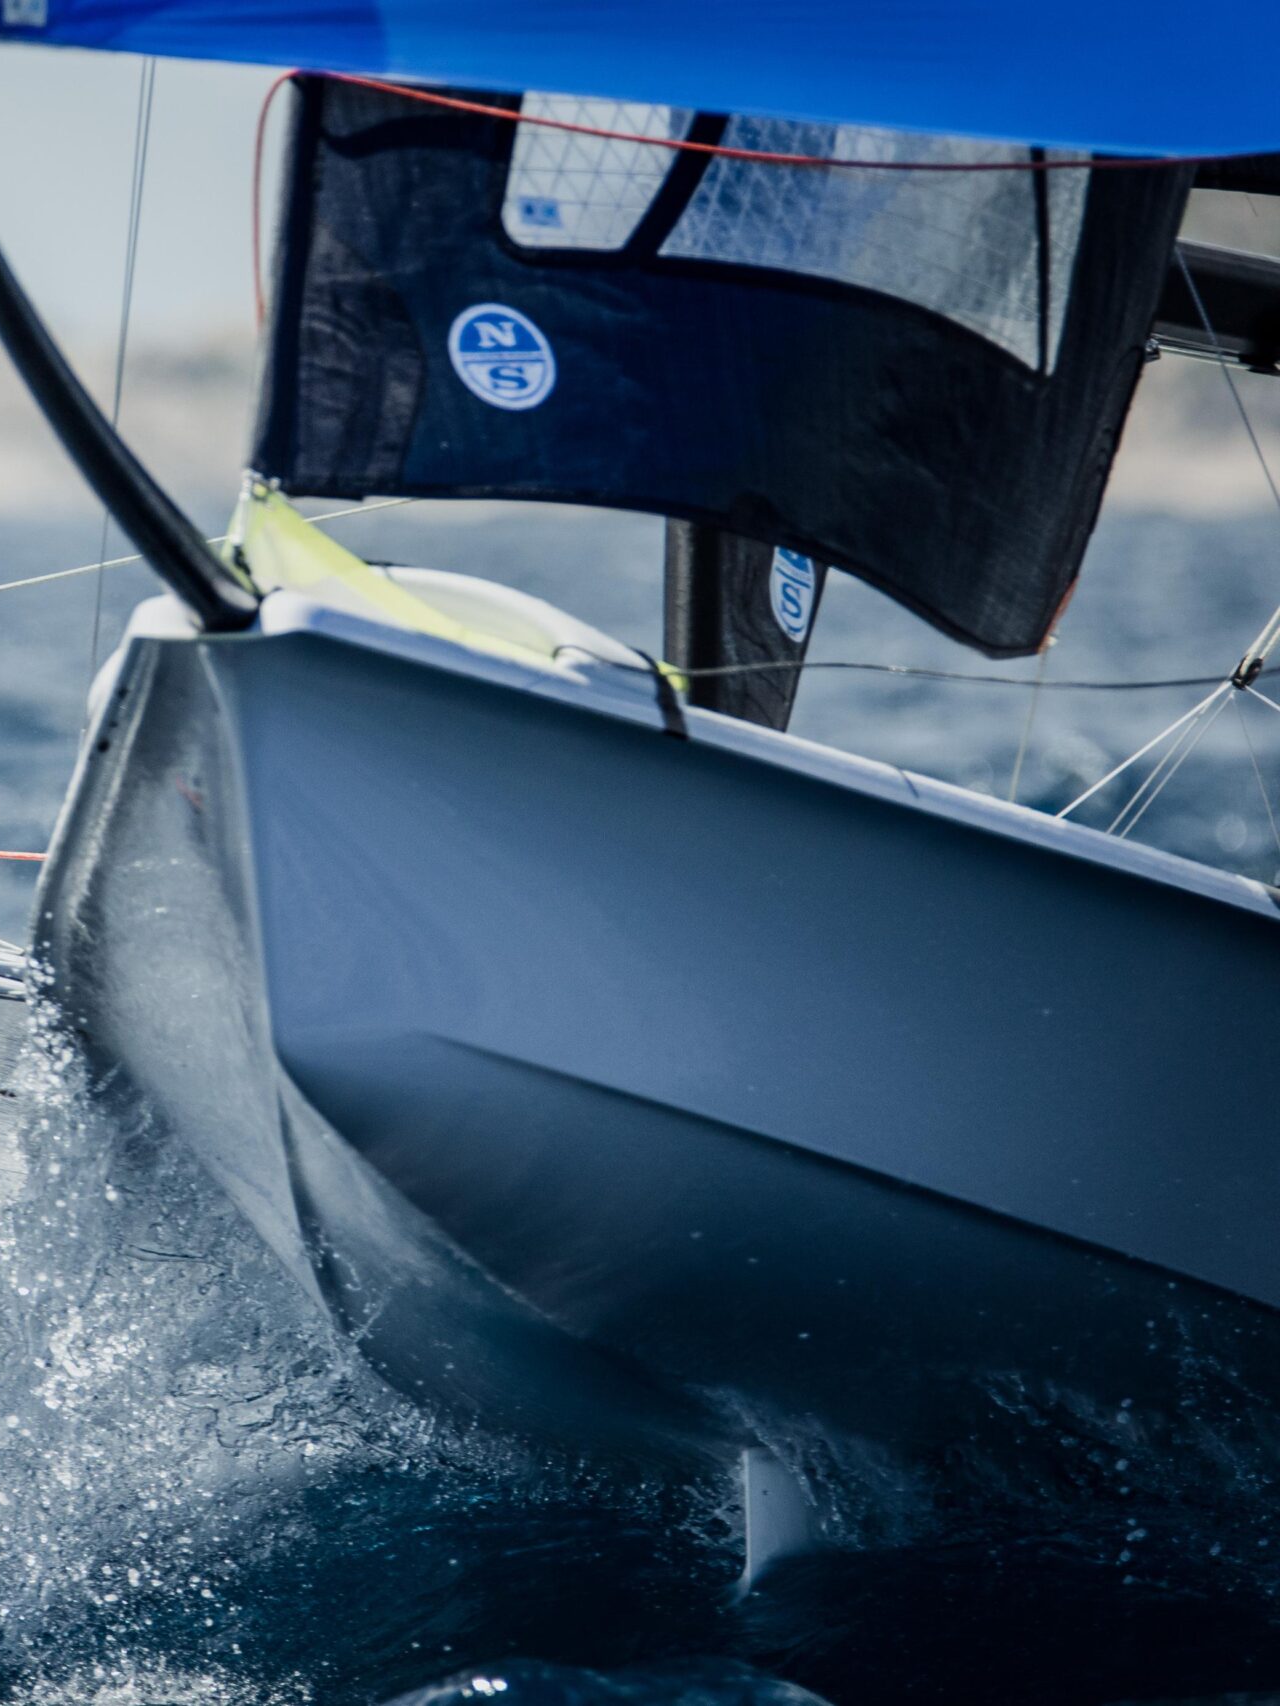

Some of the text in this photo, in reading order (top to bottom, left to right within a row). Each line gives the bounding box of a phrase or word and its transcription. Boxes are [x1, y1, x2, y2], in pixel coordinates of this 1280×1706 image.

[473, 322, 517, 348] N
[489, 366, 529, 389] S
[780, 582, 803, 620] S
